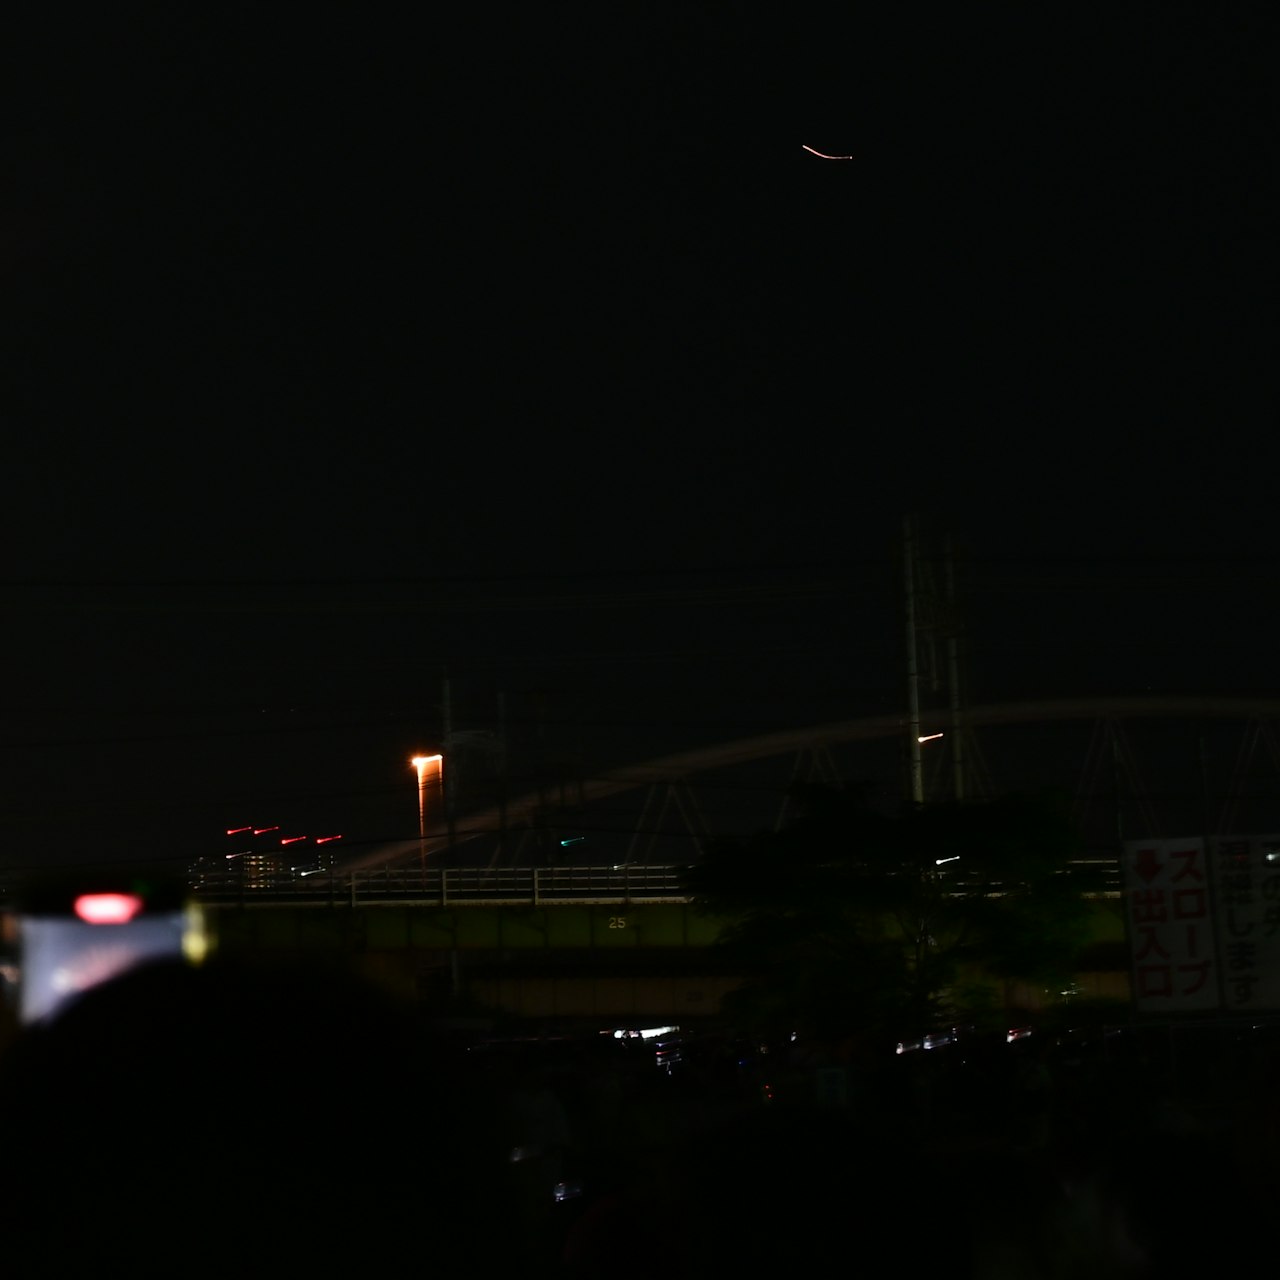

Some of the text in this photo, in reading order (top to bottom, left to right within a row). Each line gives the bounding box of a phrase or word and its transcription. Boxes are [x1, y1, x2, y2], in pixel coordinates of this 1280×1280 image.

[608, 916, 627, 929] 25
[1133, 888, 1173, 997] 出入口
[1170, 850, 1210, 996] スロープ
